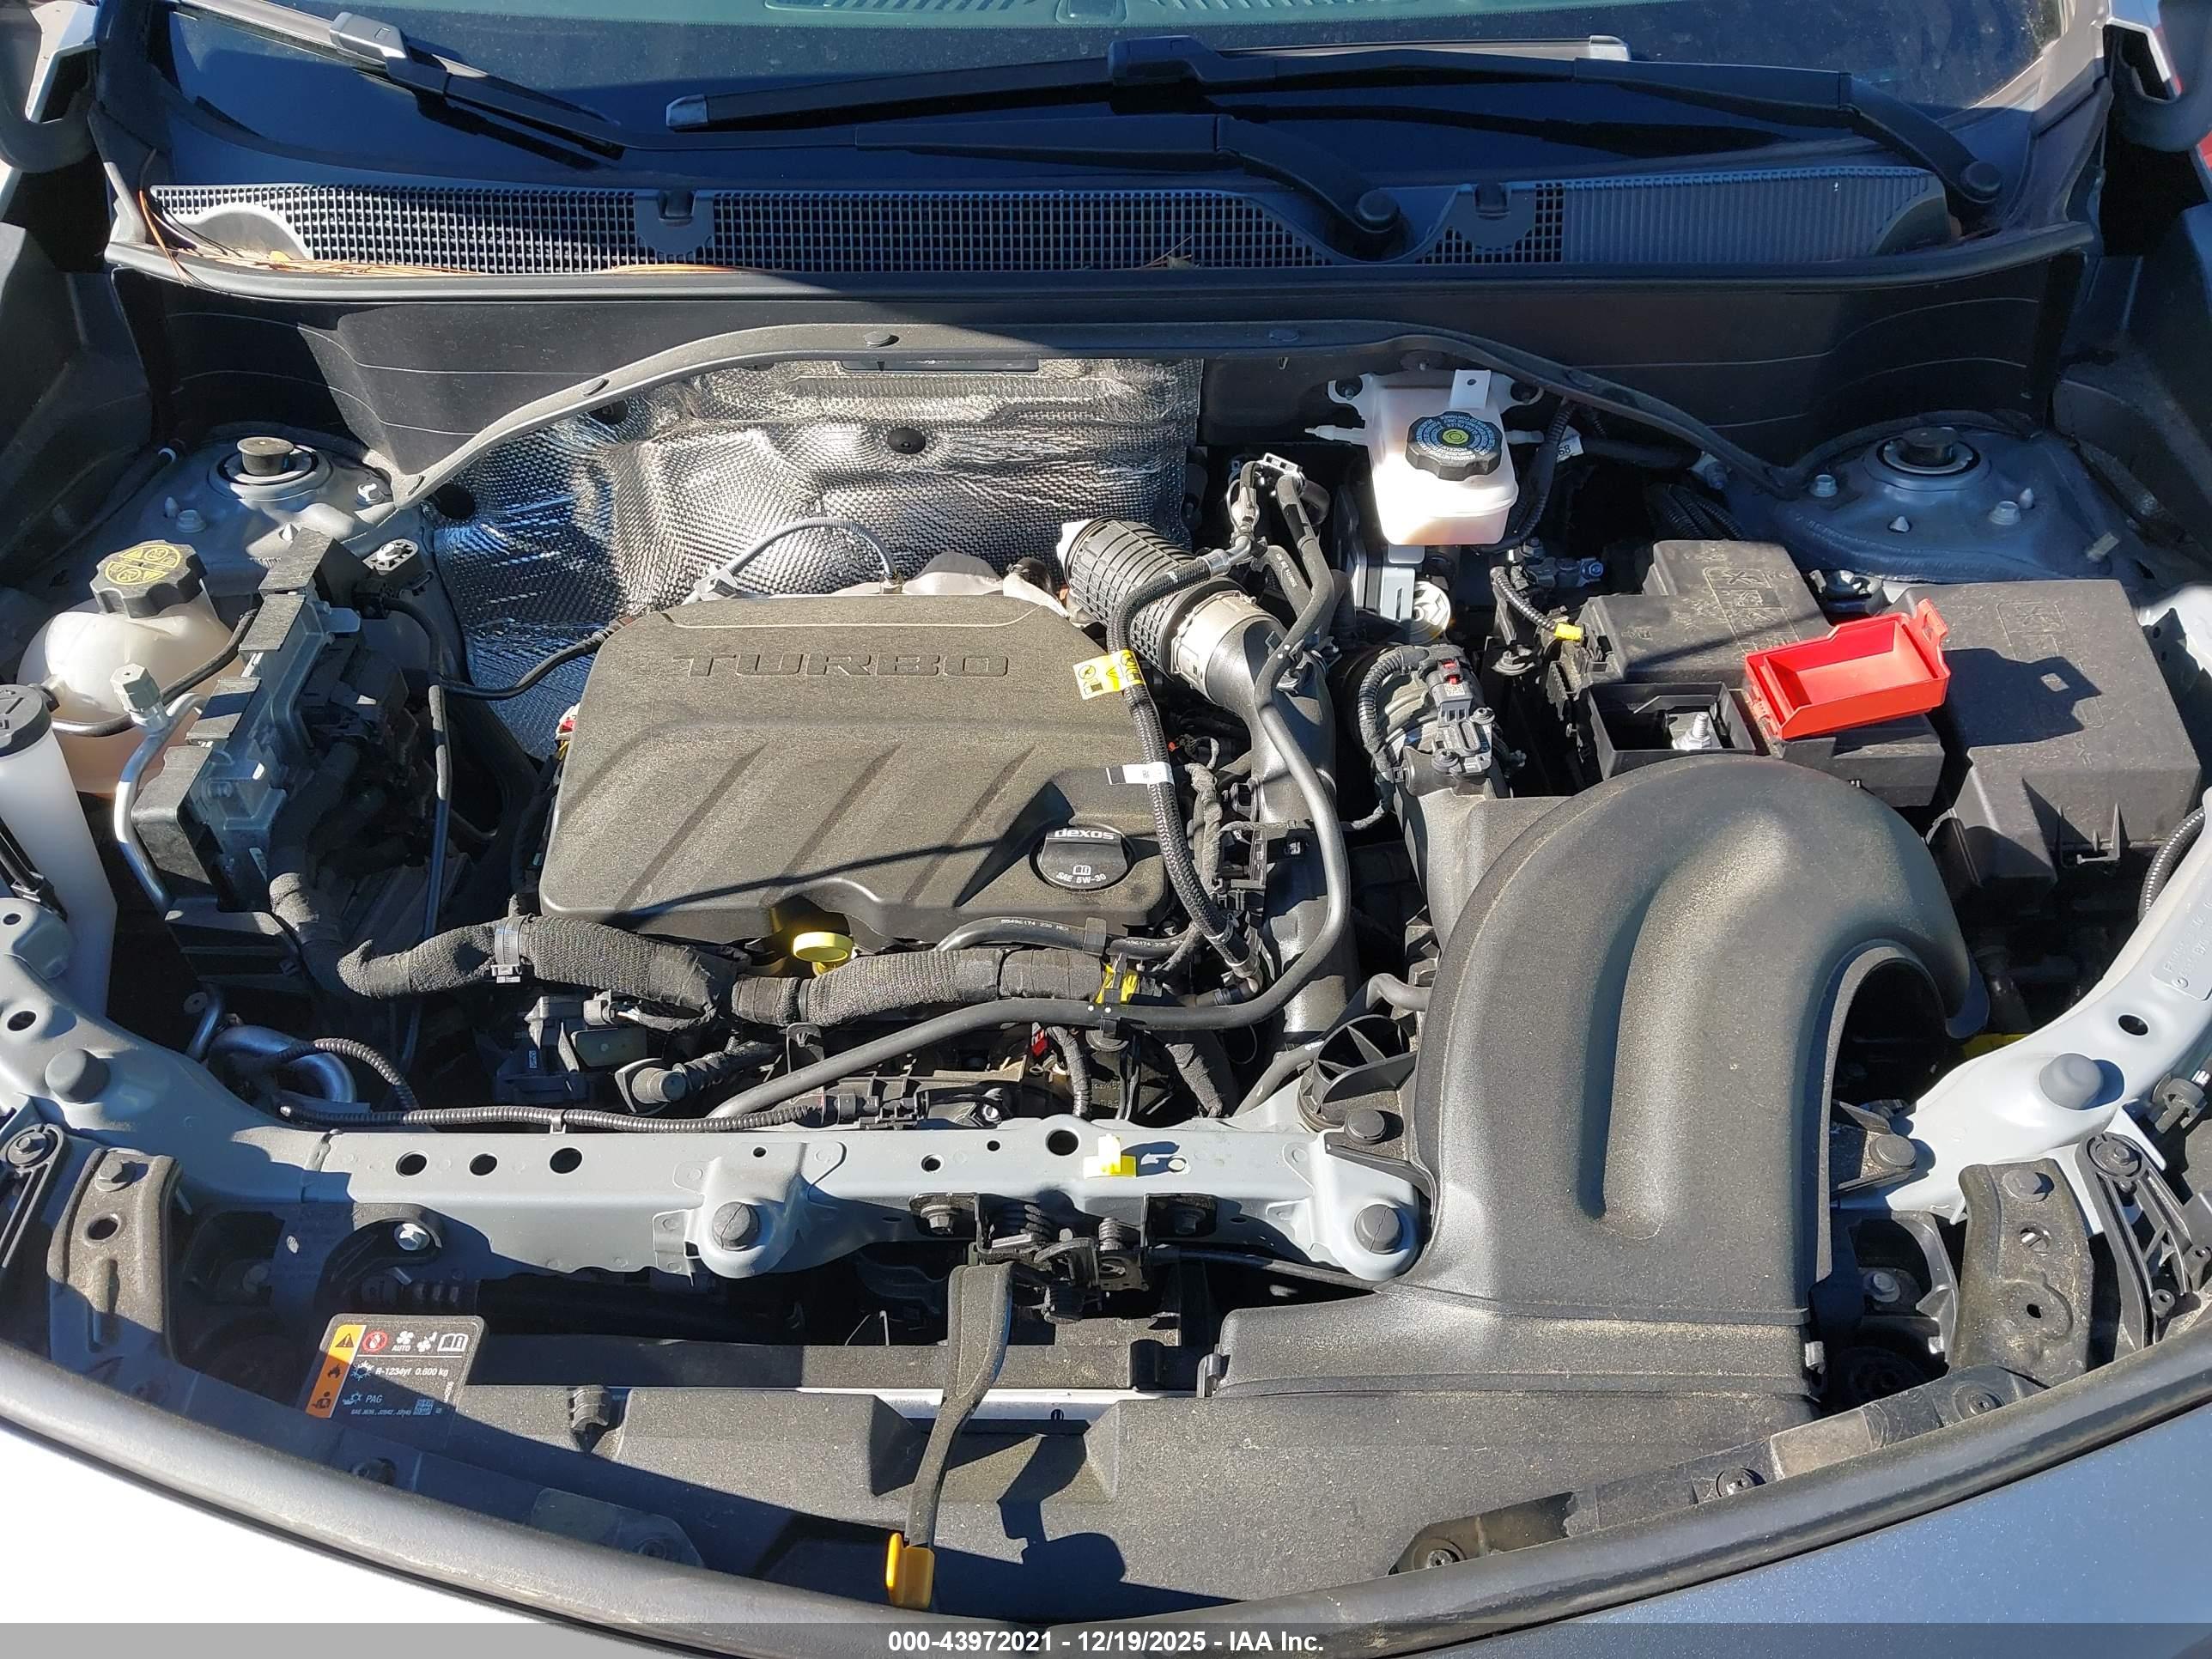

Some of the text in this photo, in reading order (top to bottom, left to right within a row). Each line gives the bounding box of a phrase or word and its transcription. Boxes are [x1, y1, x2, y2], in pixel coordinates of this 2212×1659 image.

[672, 653, 1009, 678] TURBO
[1054, 829, 1115, 840] dexos
[1055, 872, 1107, 884] SAE 5W-30
[375, 1367, 449, 1377] R-1234yf 0.600 kg
[366, 1395, 383, 1403] PAG
